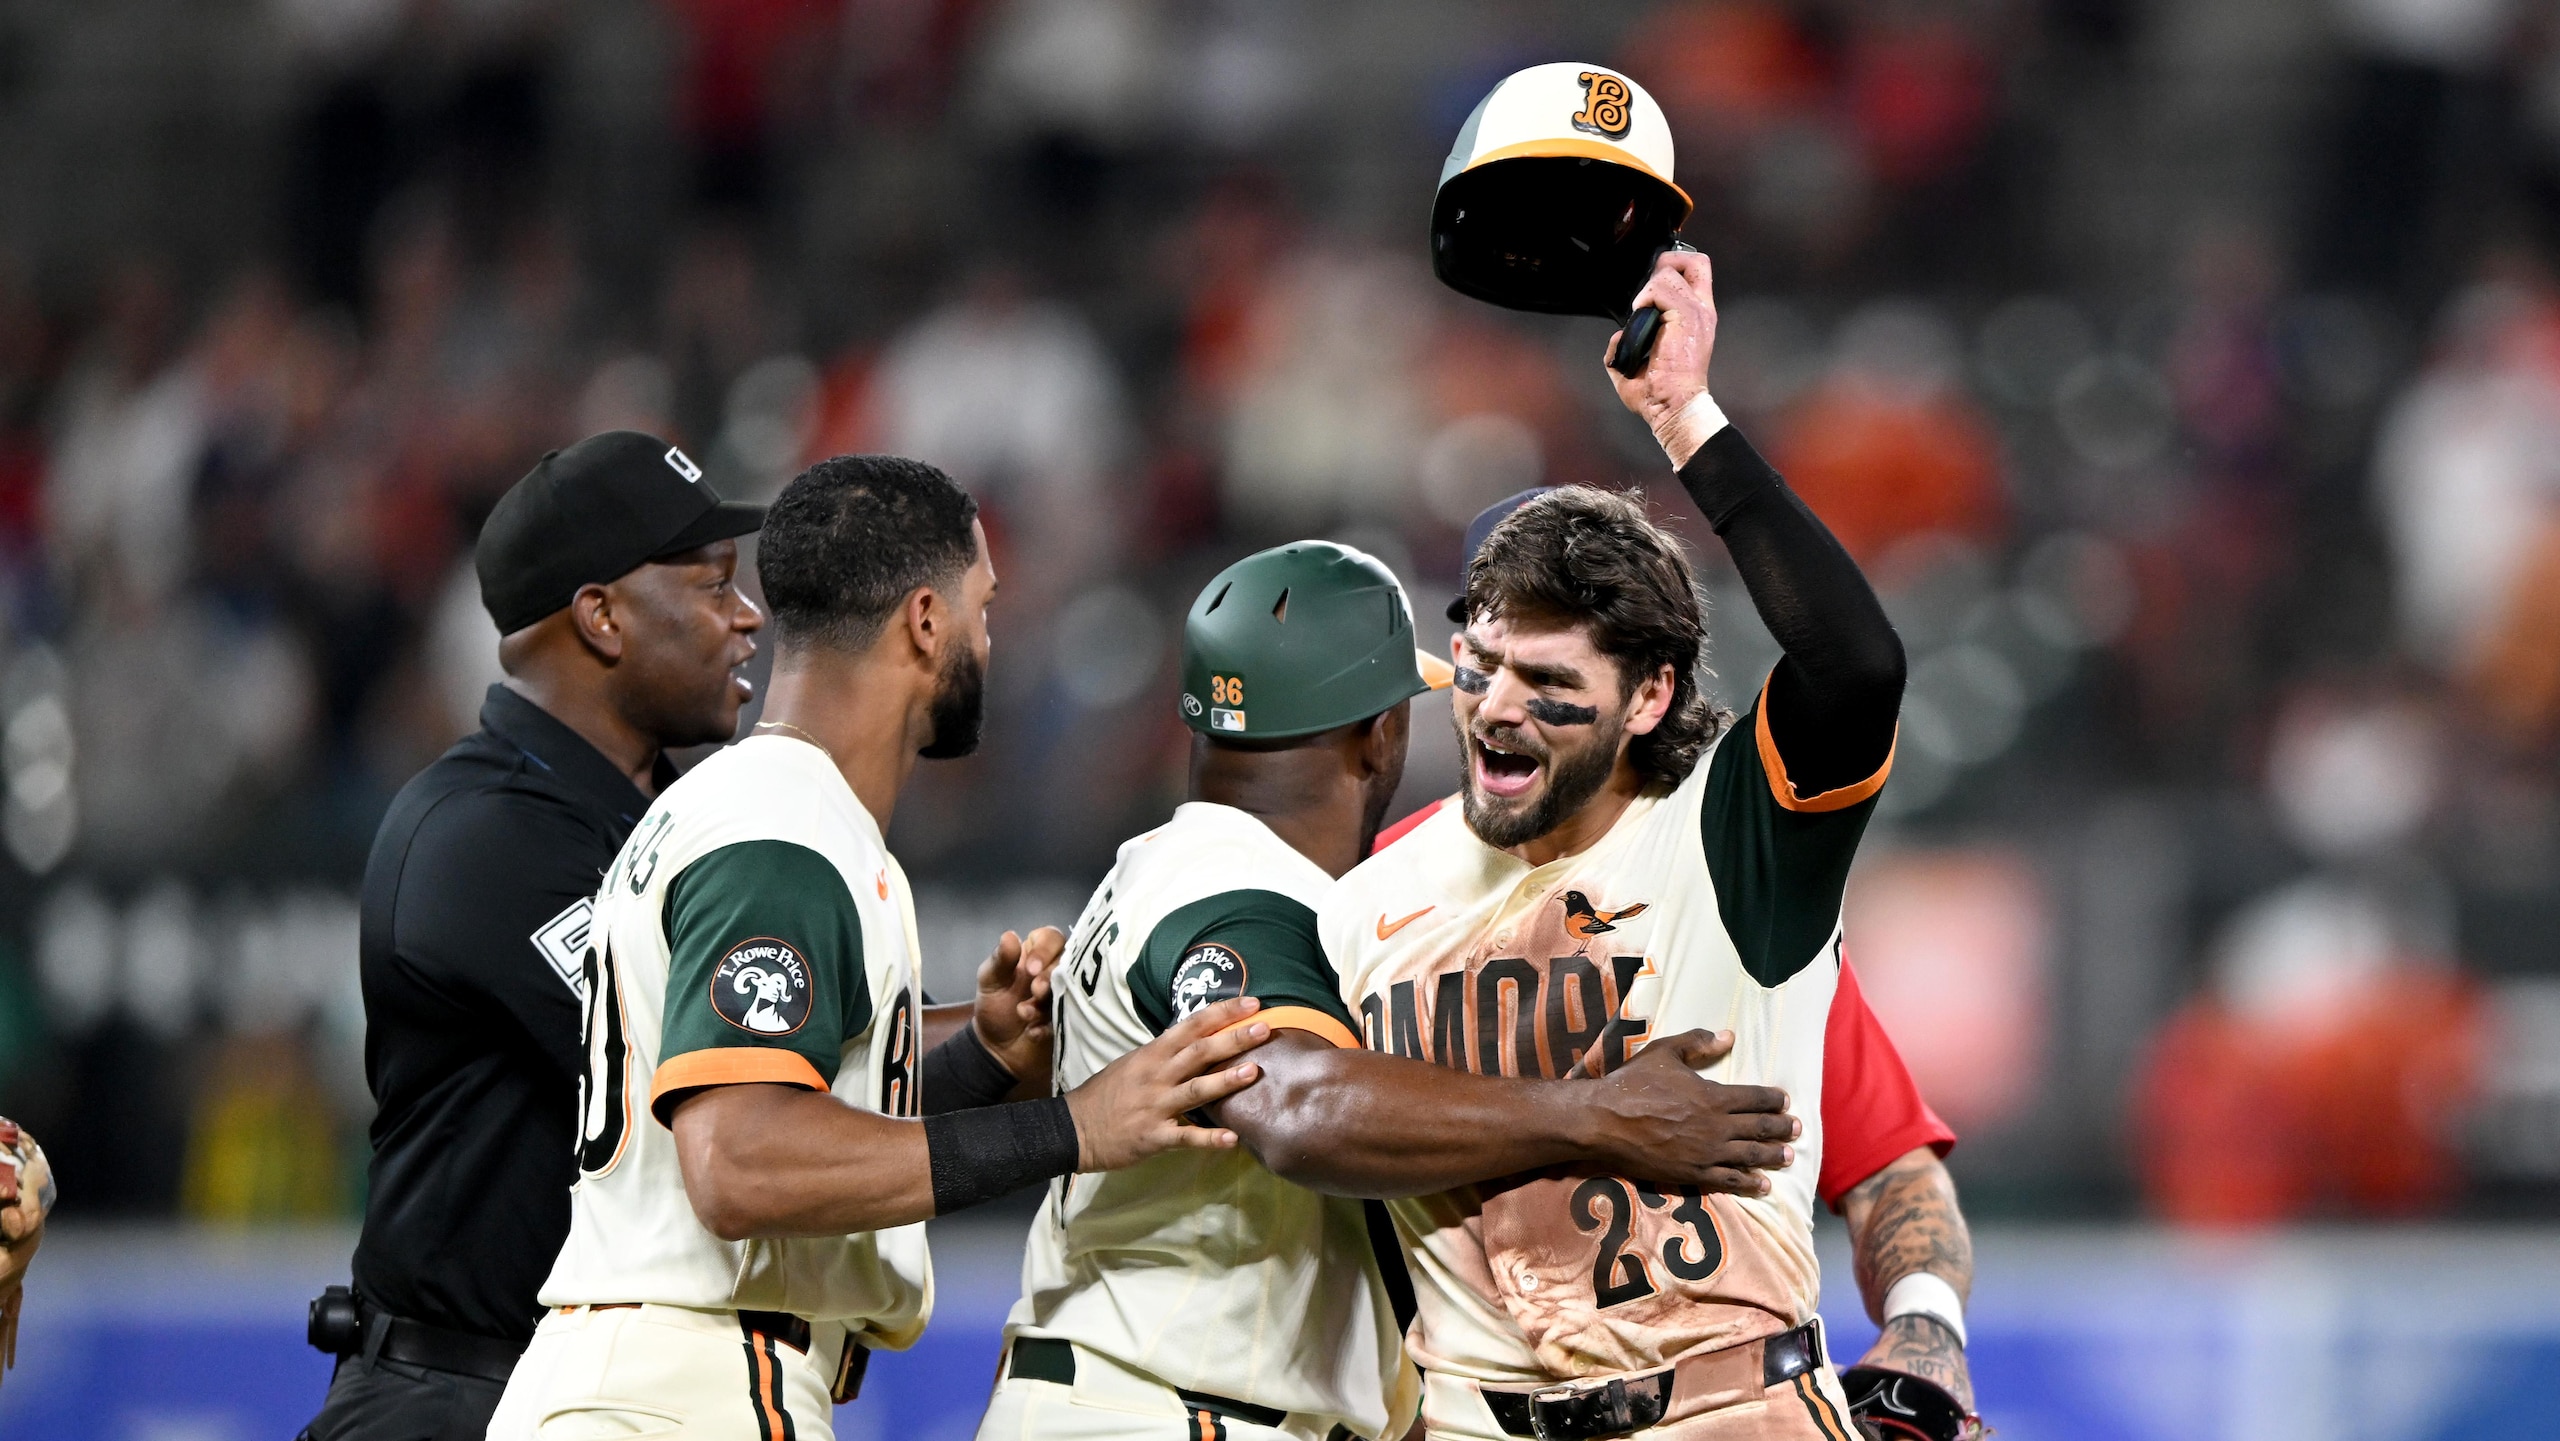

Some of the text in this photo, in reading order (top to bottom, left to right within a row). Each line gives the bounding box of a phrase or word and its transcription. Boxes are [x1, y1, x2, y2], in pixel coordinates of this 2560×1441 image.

[1571, 72, 1633, 140] B
[1211, 675, 1243, 706] 36
[717, 946, 805, 989] T. Rowe Price
[1200, 947, 1235, 972] Price
[1570, 1176, 1725, 1310] 23
